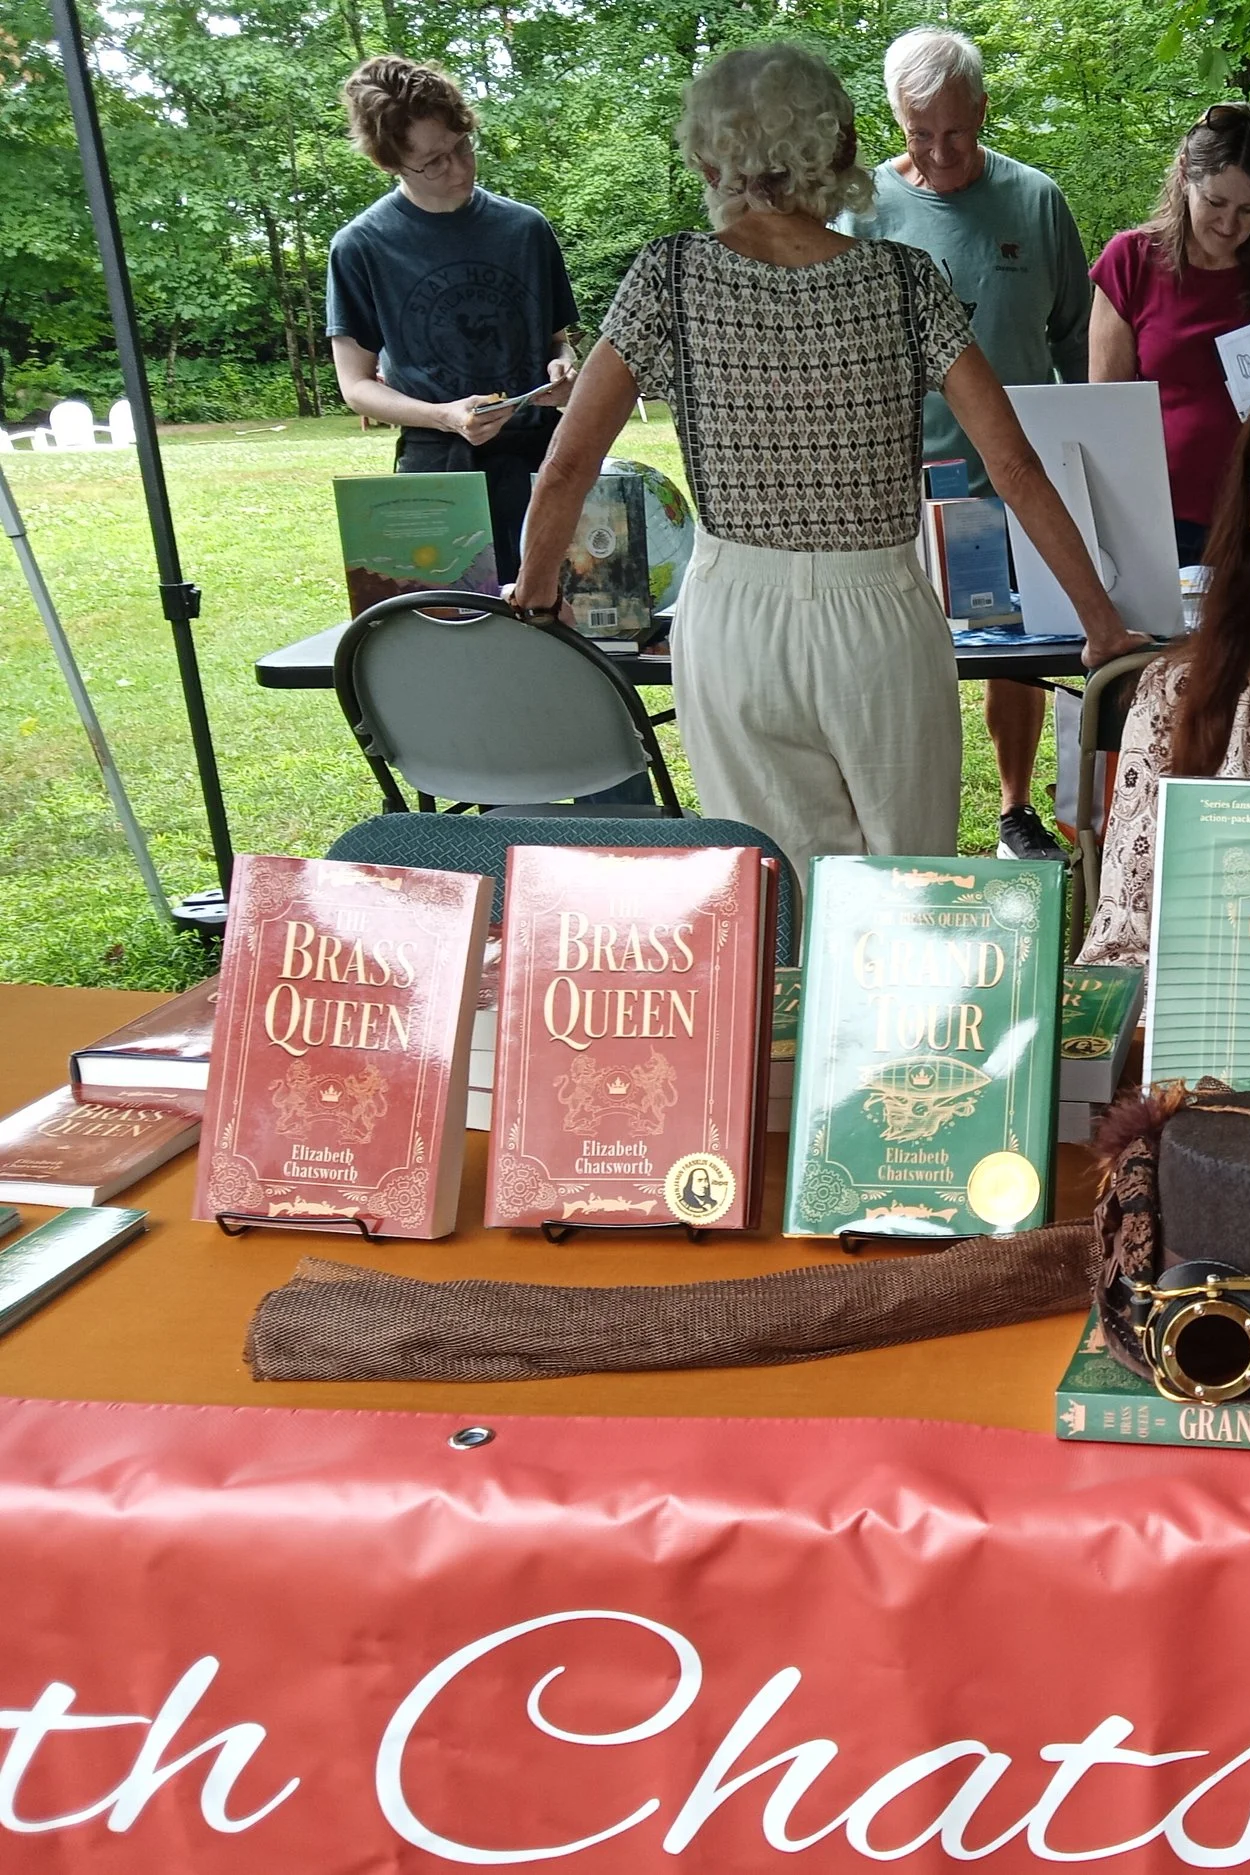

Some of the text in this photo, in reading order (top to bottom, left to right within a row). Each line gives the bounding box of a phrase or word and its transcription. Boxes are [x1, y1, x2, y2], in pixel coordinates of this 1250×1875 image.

[1231, 800, 1250, 809] fans
[335, 909, 369, 932] THE
[938, 912, 978, 929] QUEEN
[982, 914, 991, 928] II
[553, 911, 694, 974] BRASS
[277, 920, 418, 989] BRASS
[853, 930, 1005, 990] GRAND
[264, 983, 418, 1057] QUEEN
[543, 976, 700, 1051] QUEEN
[868, 994, 985, 1052] TOUR
[66, 1103, 172, 1122] BRASS
[37, 1116, 152, 1139] QUEEN
[291, 1144, 354, 1166] Elizabeth
[582, 1139, 648, 1158] Elizabeth
[885, 1147, 950, 1166] Elizabeth
[283, 1160, 359, 1184] Chatsworth
[575, 1157, 653, 1177] Chatsworth
[878, 1164, 954, 1185] Chatsworth
[1104, 1409, 1116, 1429] THE
[1120, 1406, 1133, 1435] BRASS
[1137, 1405, 1149, 1438] QUEEN
